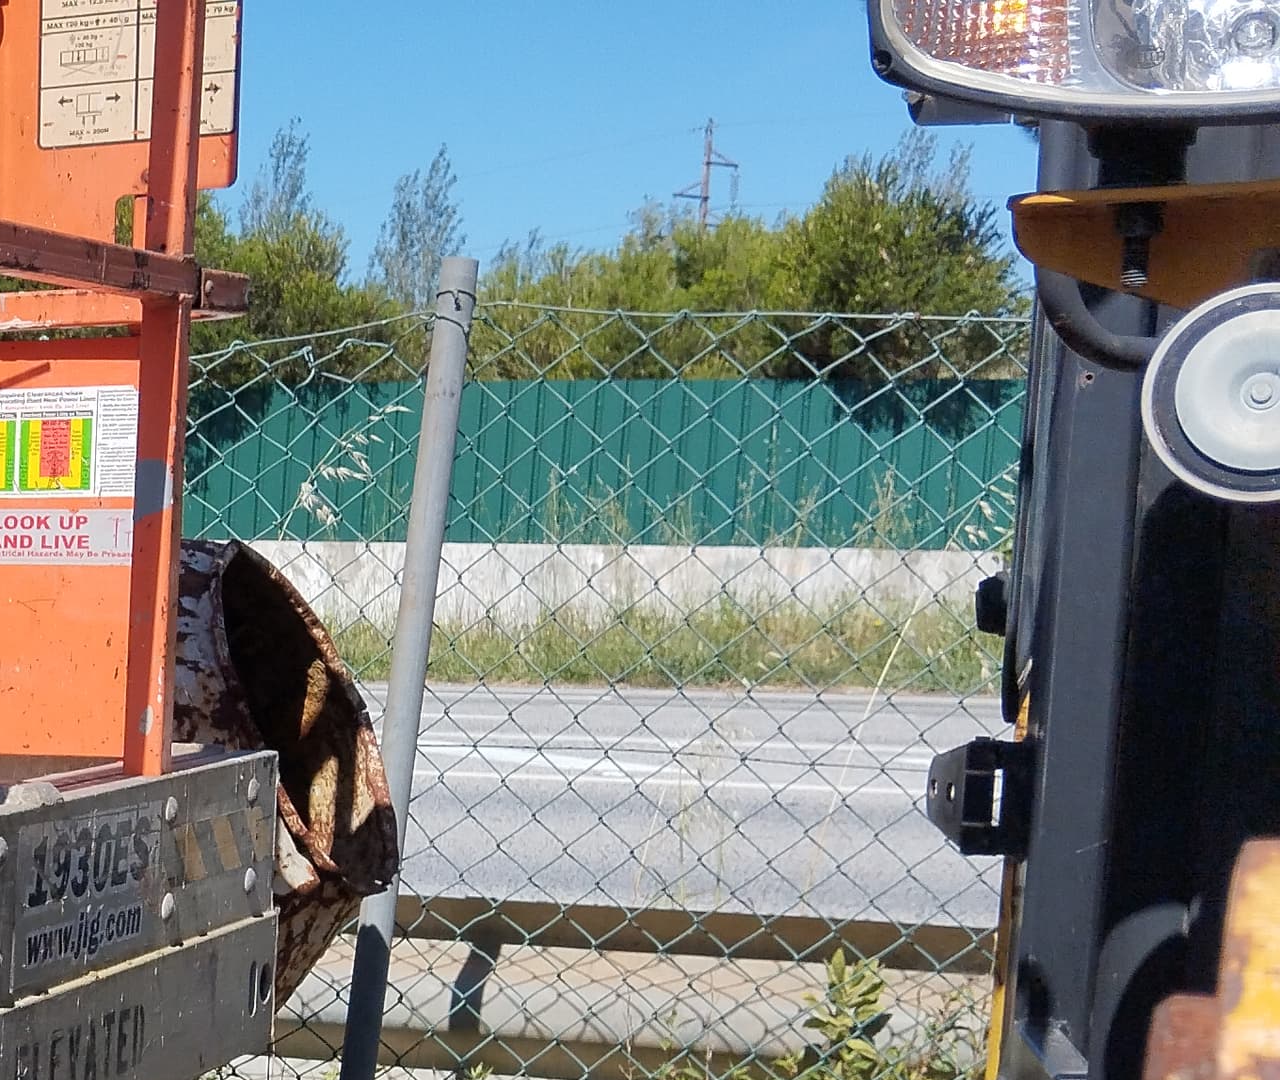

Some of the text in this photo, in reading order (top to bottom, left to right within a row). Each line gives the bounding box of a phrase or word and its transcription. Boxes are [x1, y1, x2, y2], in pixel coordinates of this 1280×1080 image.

[47, 22, 63, 30] MAX
[59, 515, 88, 530] UP
[41, 535, 90, 549] LIVE
[27, 550, 64, 558] Hazards
[66, 550, 84, 559] May
[28, 816, 151, 908] 1930ES
[27, 904, 142, 965] www.jlg.com
